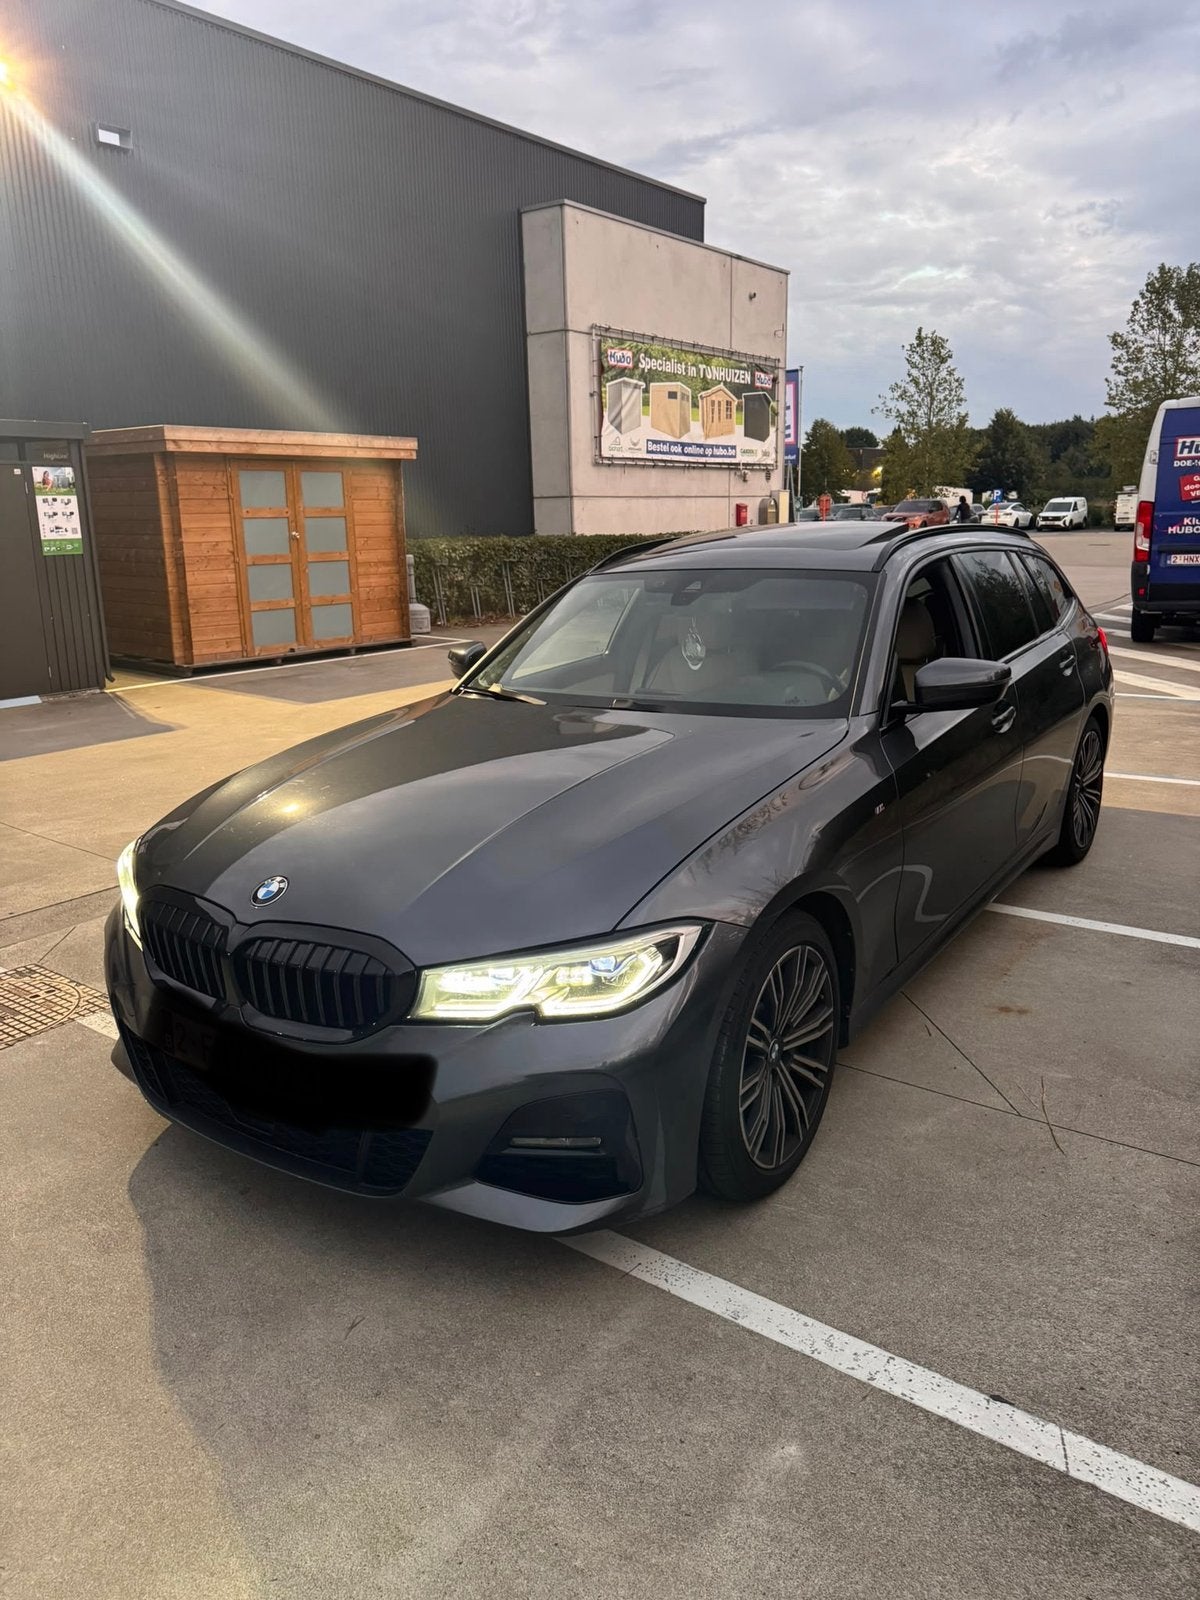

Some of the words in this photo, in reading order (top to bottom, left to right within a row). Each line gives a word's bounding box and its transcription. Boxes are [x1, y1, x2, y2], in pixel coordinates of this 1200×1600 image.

[638, 353, 686, 375] Specialist
[687, 364, 697, 377] in
[647, 441, 669, 452] Bestel
[670, 444, 683, 453] ook
[683, 445, 704, 454] online
[704, 448, 712, 456] op
[713, 447, 736, 456] hubo.be
[993, 489, 1001, 500] P
